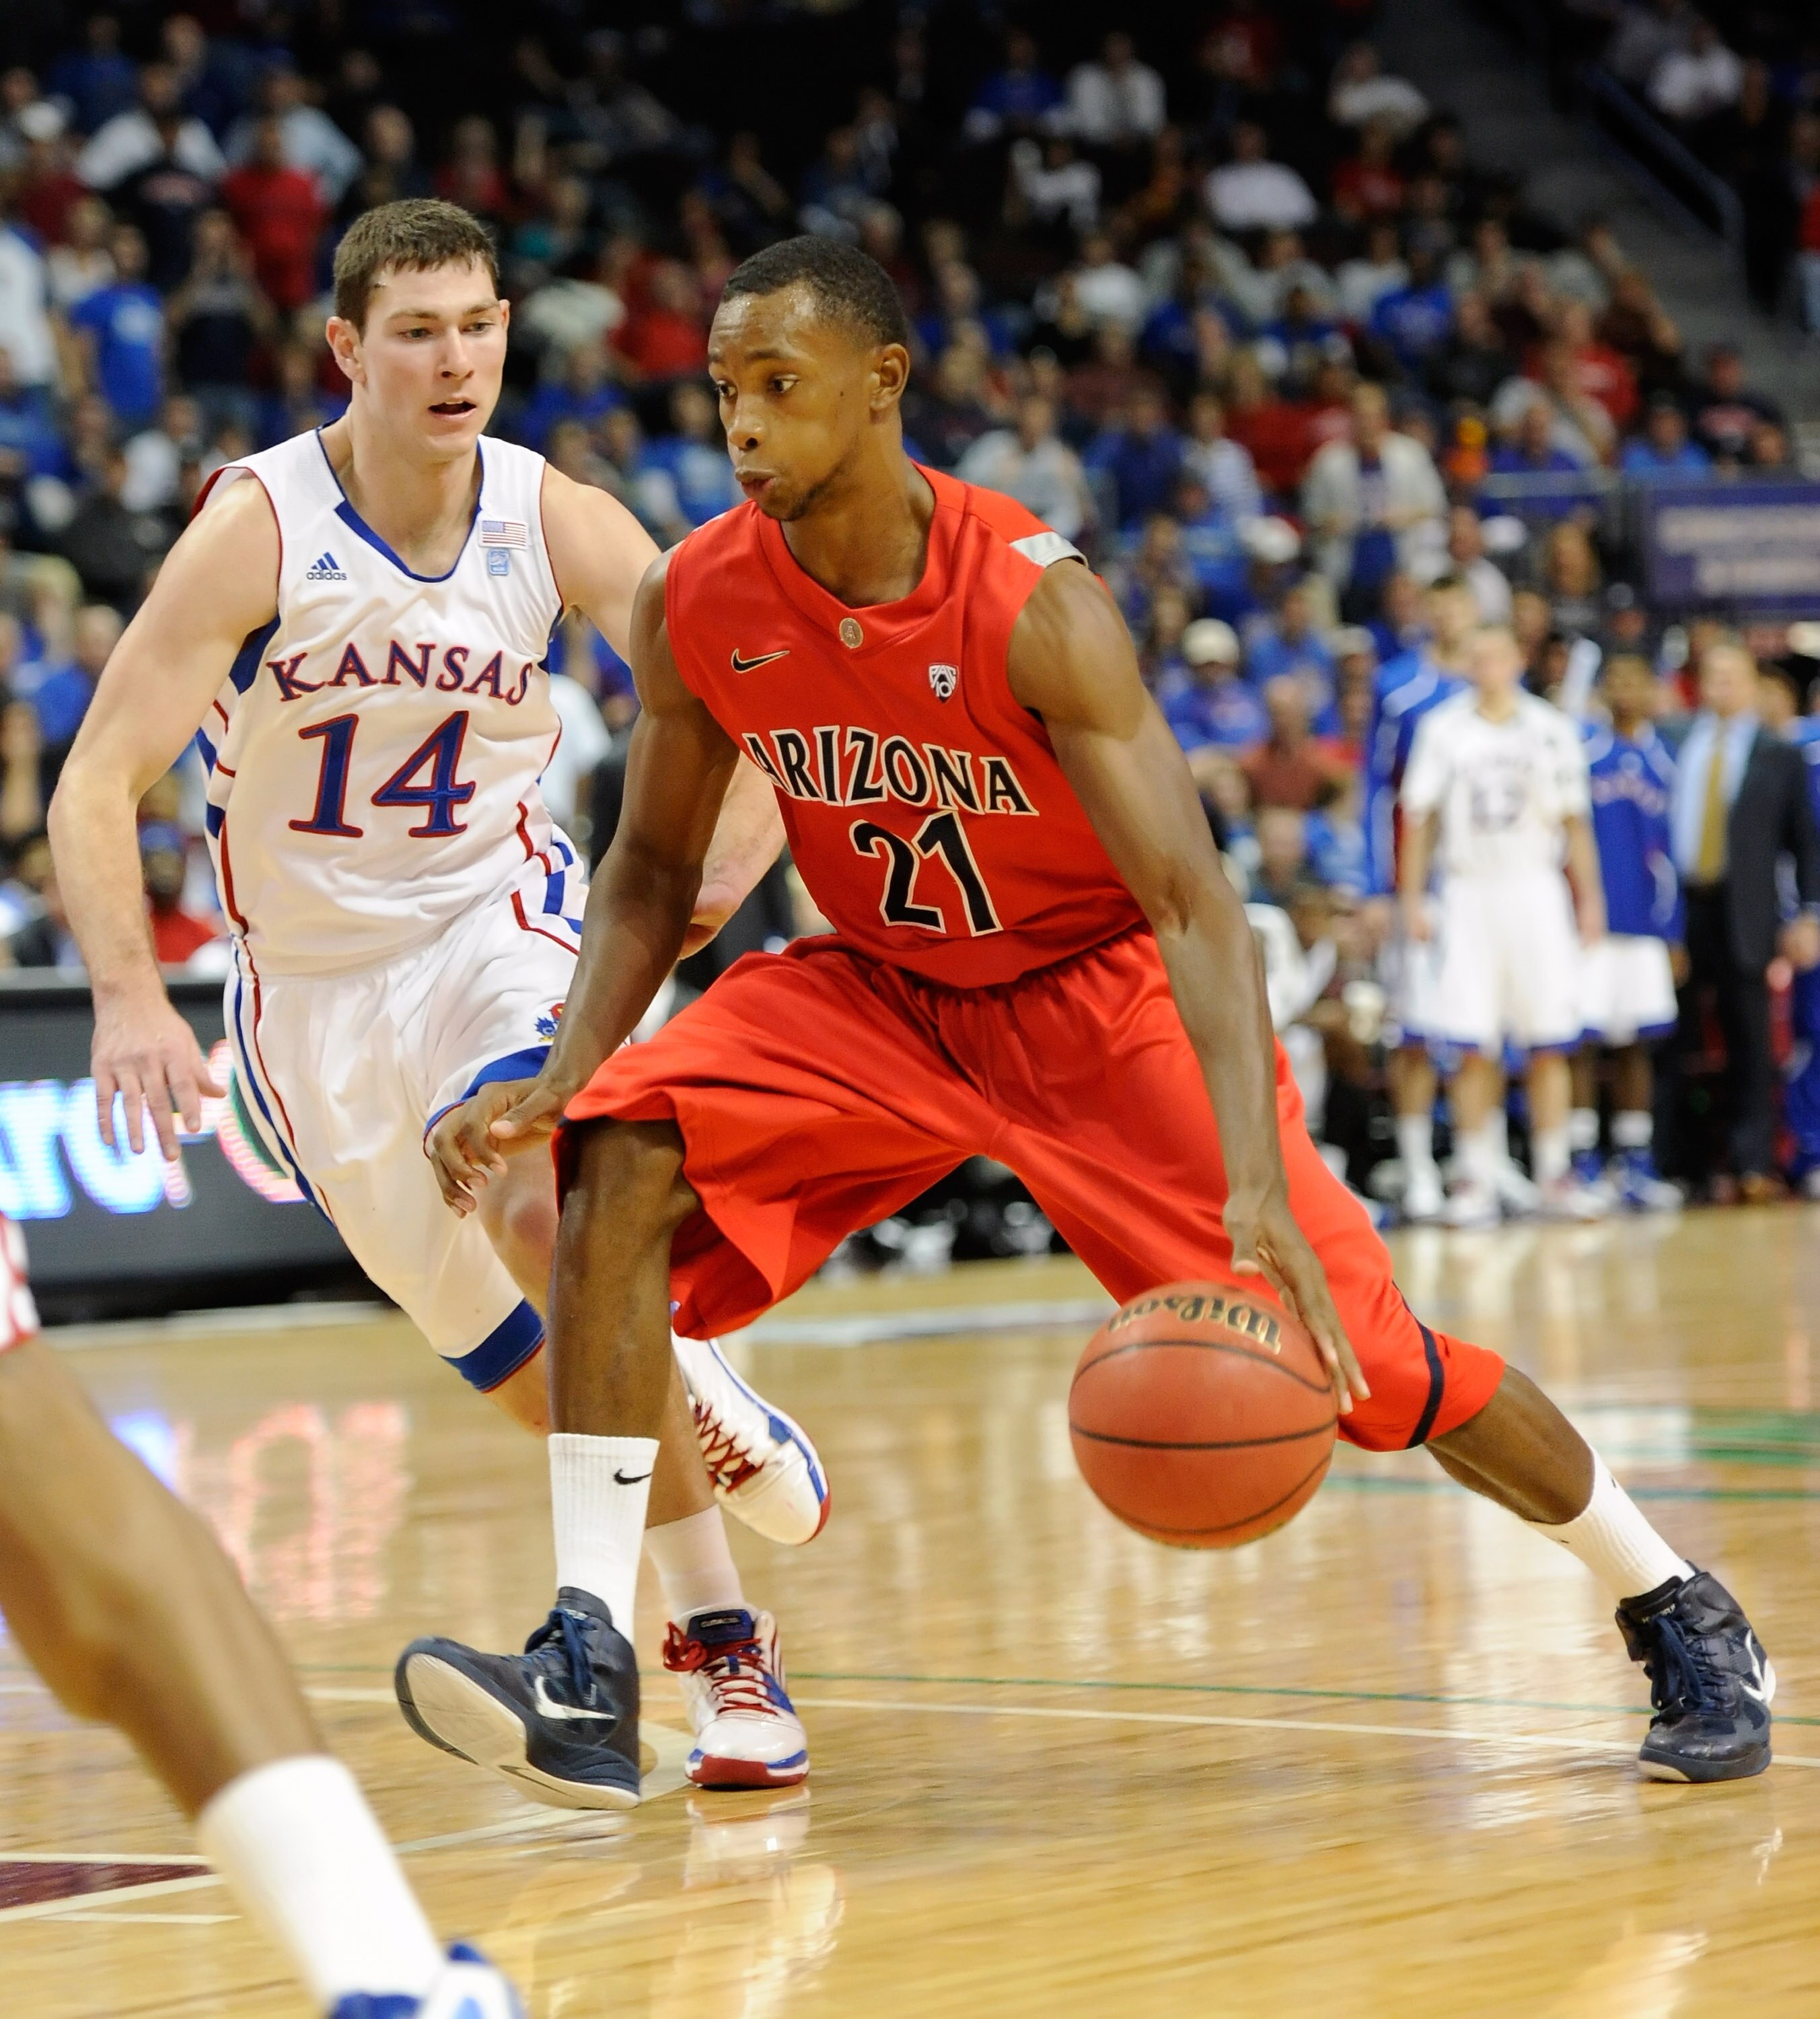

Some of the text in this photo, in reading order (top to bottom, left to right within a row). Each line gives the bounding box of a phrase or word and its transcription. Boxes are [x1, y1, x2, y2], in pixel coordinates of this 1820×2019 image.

[306, 569, 347, 580] adidas
[266, 640, 533, 706] KANSAS
[288, 710, 476, 838] 14
[741, 725, 1040, 816] ARIZONA
[849, 809, 1004, 937] 21
[1107, 1296, 1282, 1355] Wilson
